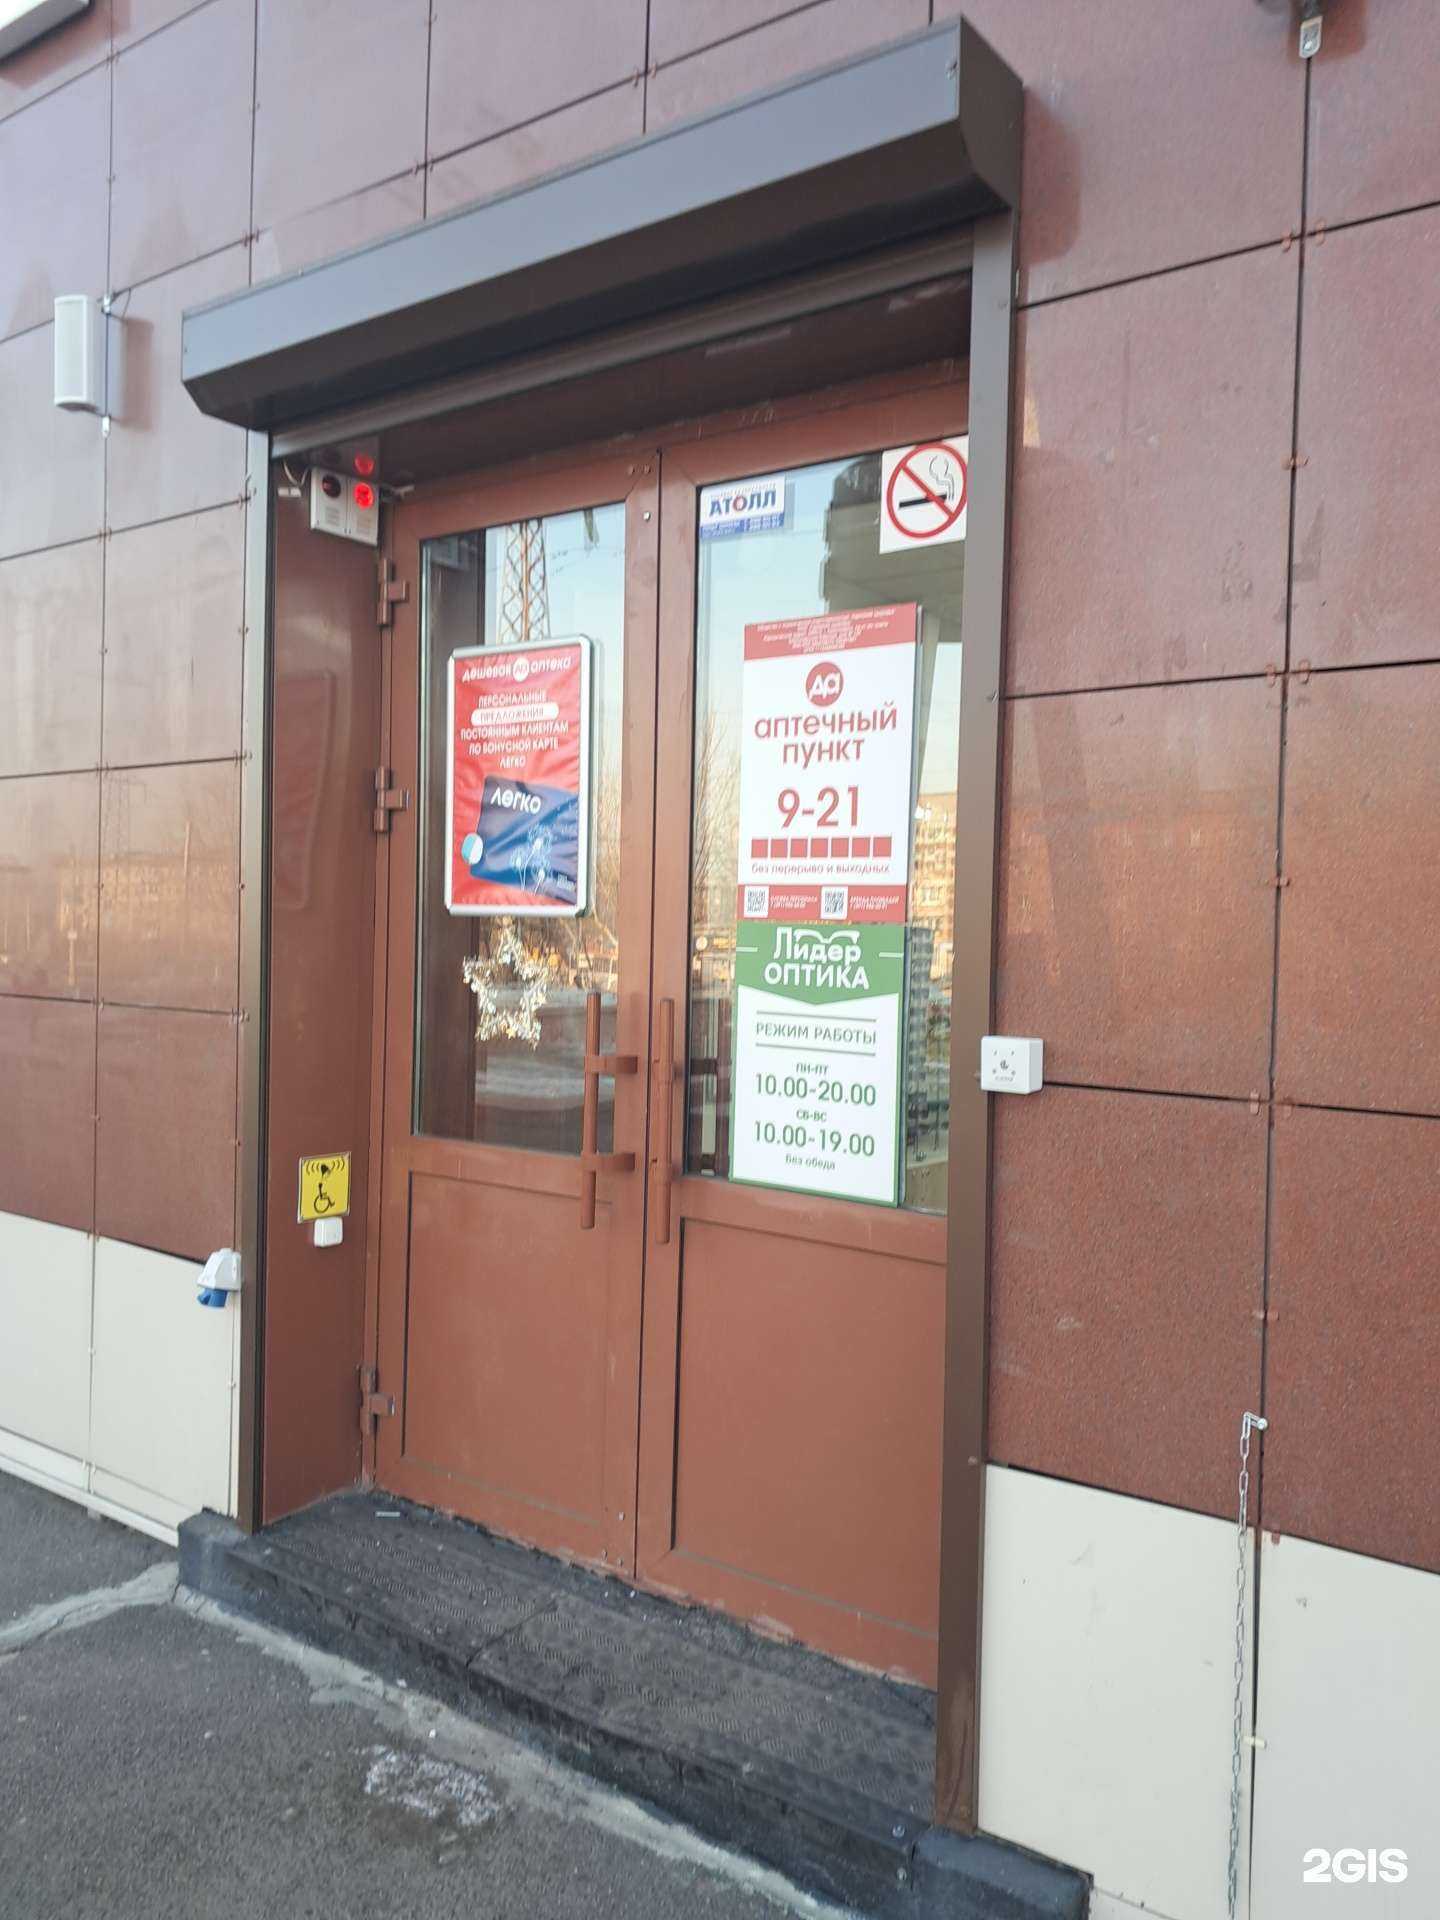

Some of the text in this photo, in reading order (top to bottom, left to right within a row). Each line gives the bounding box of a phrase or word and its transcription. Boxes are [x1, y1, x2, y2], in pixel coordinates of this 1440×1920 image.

[708, 490, 777, 517] АТОЛЛ
[478, 690, 548, 708] ПЕРСОНАЛЬНЫЕ
[479, 707, 544, 724] ПРЕДЛОЖЕНИЯ
[754, 701, 897, 739] аптечный
[460, 721, 570, 741] ПОСТОЯННЫМ КЛИЕНТАМ
[468, 736, 560, 755] ПО БОНУСНОЙ КАРТЕ
[782, 738, 865, 770] пункт
[777, 785, 860, 829] 9-21
[836, 862, 891, 876] выходных
[773, 927, 862, 965] Лидер
[763, 961, 870, 990] ОПТИКА
[755, 1020, 878, 1045] РЕЖИМ РАБОТЫ
[754, 1073, 877, 1106] 10.00-20.00
[754, 1120, 876, 1157] 10.00-19.00
[784, 1153, 836, 1171] Без обеда
